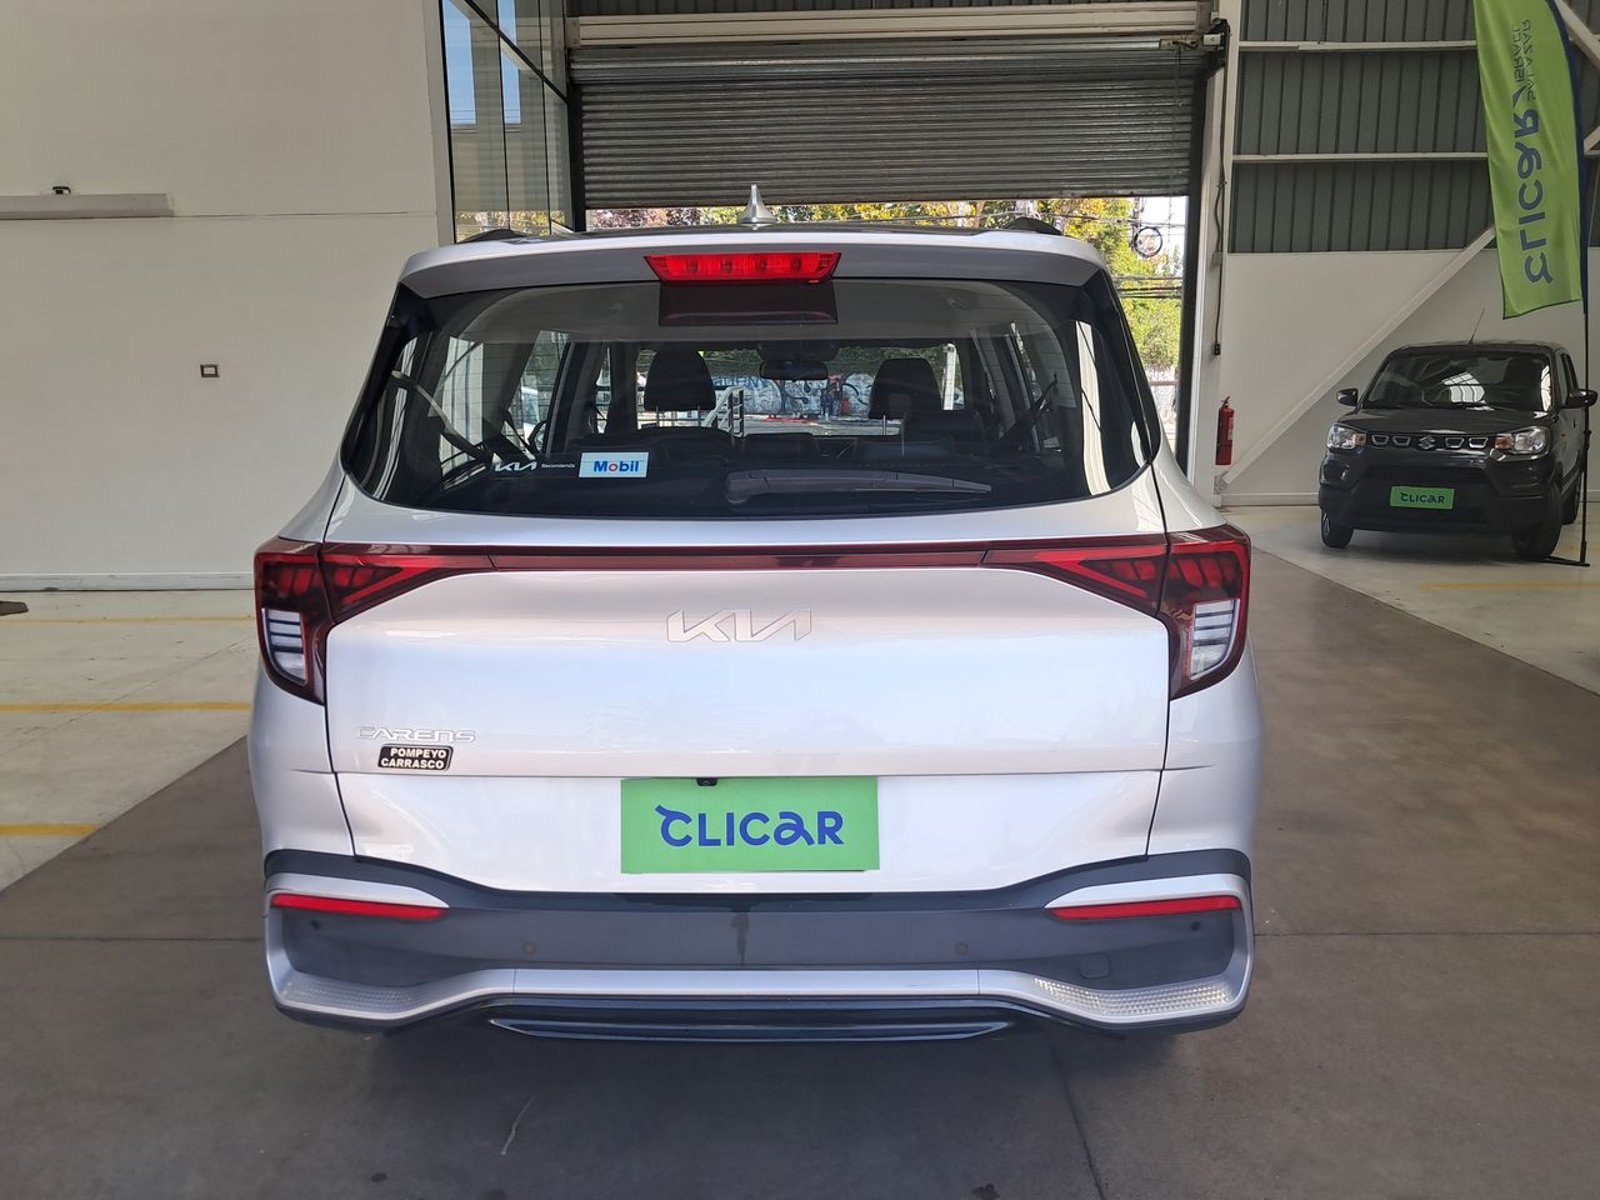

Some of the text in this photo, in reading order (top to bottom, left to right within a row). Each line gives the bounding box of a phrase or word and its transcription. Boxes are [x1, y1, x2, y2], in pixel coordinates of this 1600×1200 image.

[494, 461, 537, 472] KIA
[593, 460, 639, 472] Mobil
[666, 608, 812, 642] KIA
[357, 726, 476, 743] CARENS
[390, 748, 447, 759] POMPEYO
[381, 758, 444, 769] CARRASCO
